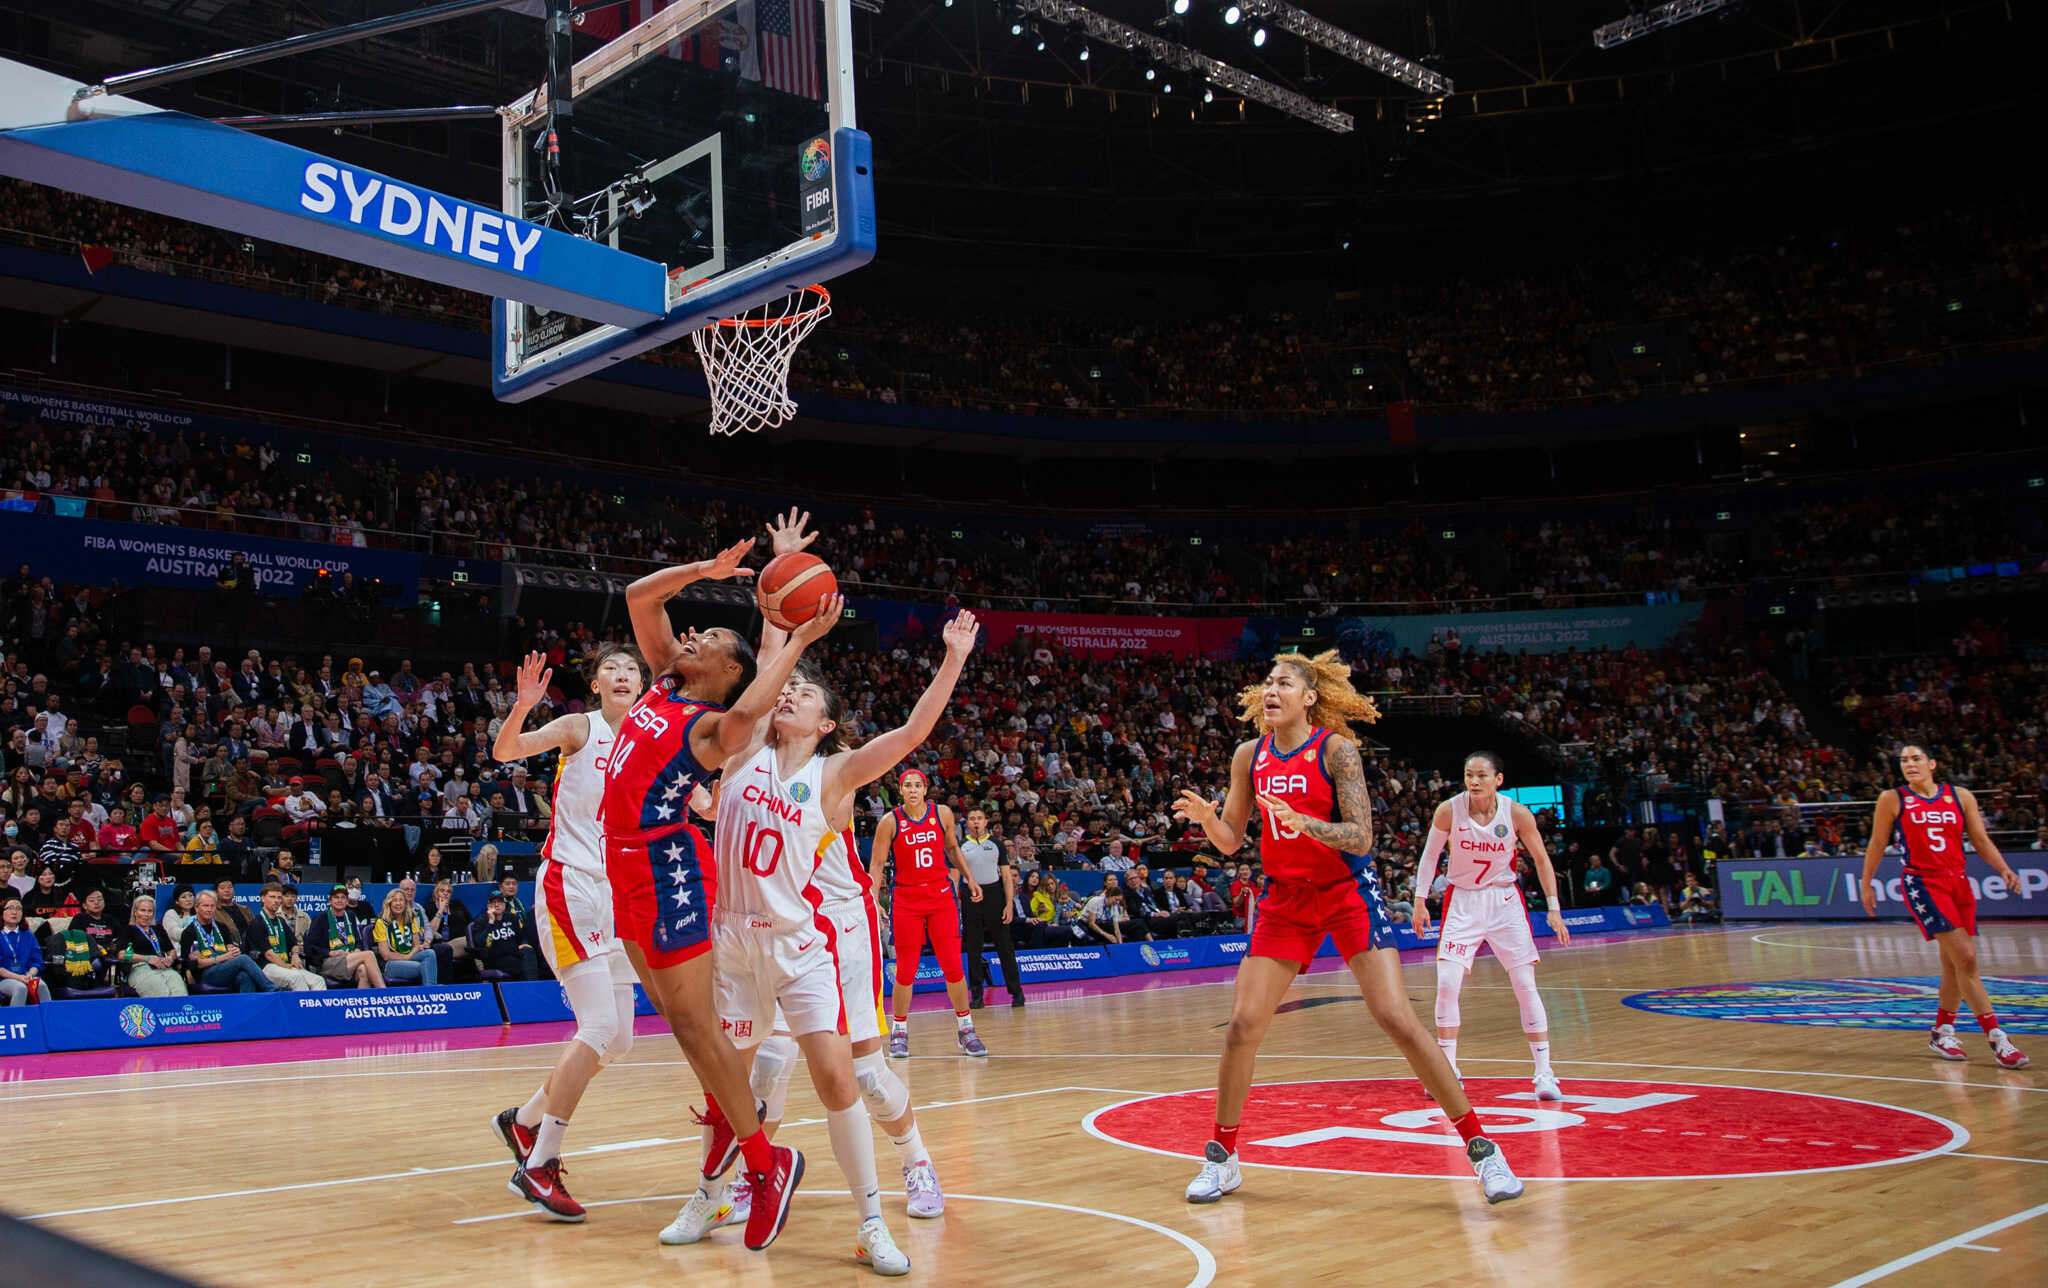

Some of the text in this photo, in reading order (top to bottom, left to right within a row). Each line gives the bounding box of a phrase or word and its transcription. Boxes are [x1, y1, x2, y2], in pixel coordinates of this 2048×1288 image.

[806, 187, 830, 212] FIBA
[301, 162, 541, 271] SYDNEY
[22, 393, 70, 408] WOMEN'S
[72, 401, 135, 418] BASKETBALL
[136, 410, 172, 424] WORLD
[173, 415, 192, 425] CUP
[40, 408, 115, 428] AUSTRALIA
[84, 535, 350, 573] FIBA WOMEN'S BASKEBALL WORLD CUP
[1080, 627, 1133, 636] BASKETBALL
[1133, 628, 1164, 637] WORLD
[1165, 629, 1181, 638] CUP
[1459, 624, 1504, 633] WOMEN'S
[1507, 621, 1569, 632] BASKETBALL
[1572, 619, 1609, 629] WORLD
[1610, 617, 1632, 627] CUP
[1120, 638, 1148, 649] 2022
[1480, 630, 1589, 645] AUSTRALIA 2022
[628, 699, 669, 739] USA
[607, 733, 636, 780] 14
[1257, 774, 1307, 795] USA
[742, 785, 803, 827] CHINA
[1910, 811, 1957, 825] USA
[905, 830, 937, 845] USA
[1460, 840, 1505, 852] CHINA
[1927, 827, 1946, 852] 5
[741, 821, 784, 878] 10
[915, 847, 933, 868] 16
[1473, 859, 1491, 884] 7
[1730, 869, 1821, 906] TAL
[752, 920, 772, 928] CHN
[492, 927, 516, 940] USA
[1033, 953, 1067, 962] BASKETBALL
[1068, 952, 1088, 960] WORLD
[1089, 951, 1101, 959] CUP
[1021, 960, 1083, 972] AUSTRALIA 2022
[300, 991, 482, 1008] FIBA WOMEN'S BASKETBALL WORLD CUP
[159, 1013, 223, 1026] WORLD CUP
[345, 1004, 448, 1019] AUSTRALIA 2022
[10, 1024, 27, 1039] IT
